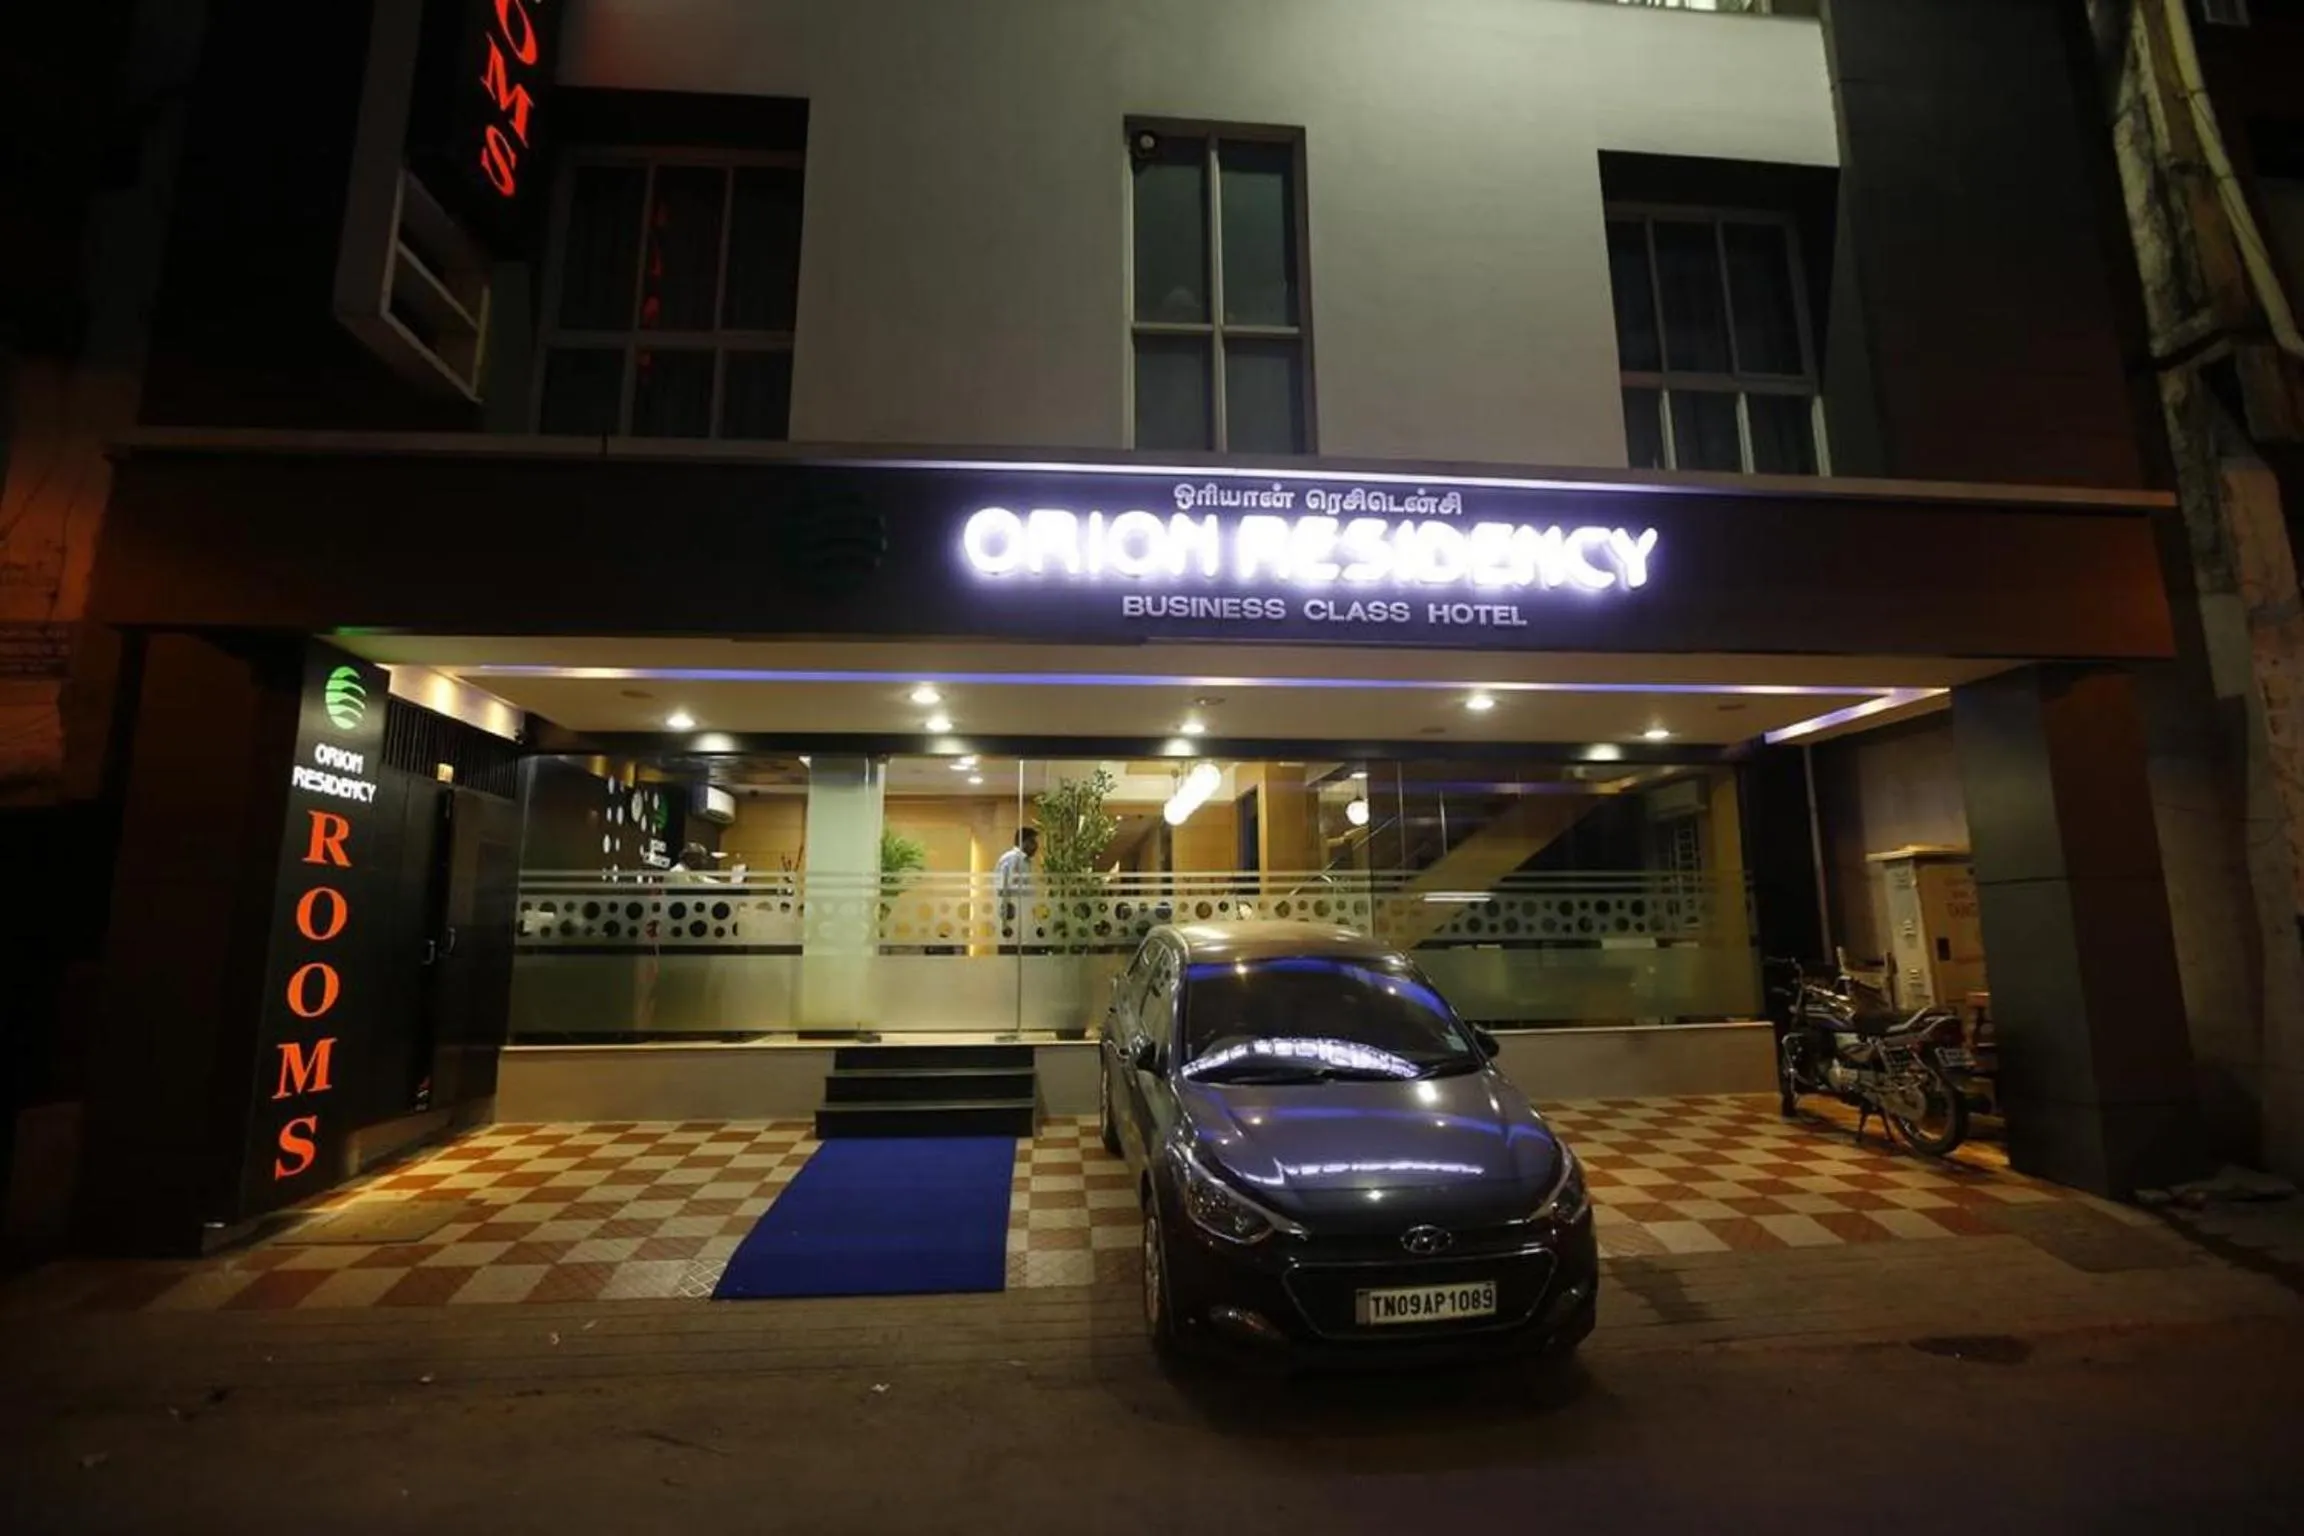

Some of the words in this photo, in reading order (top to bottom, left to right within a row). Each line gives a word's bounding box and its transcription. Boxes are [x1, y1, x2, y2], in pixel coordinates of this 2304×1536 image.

[1174, 482, 1295, 511] ஒரியான்
[1305, 488, 1464, 516] ரெசிடென்சி
[963, 506, 1220, 578] ORION
[1237, 513, 1659, 590] RESIDENCY
[1122, 595, 1287, 621] BUSINESS
[1303, 599, 1411, 623] CLASS
[1428, 602, 1527, 627] HOTEL
[314, 742, 364, 775] ORION
[292, 765, 376, 804] RESIDENCY
[272, 810, 352, 1181] ROOMS
[1371, 1288, 1493, 1318] TN09AP1089
